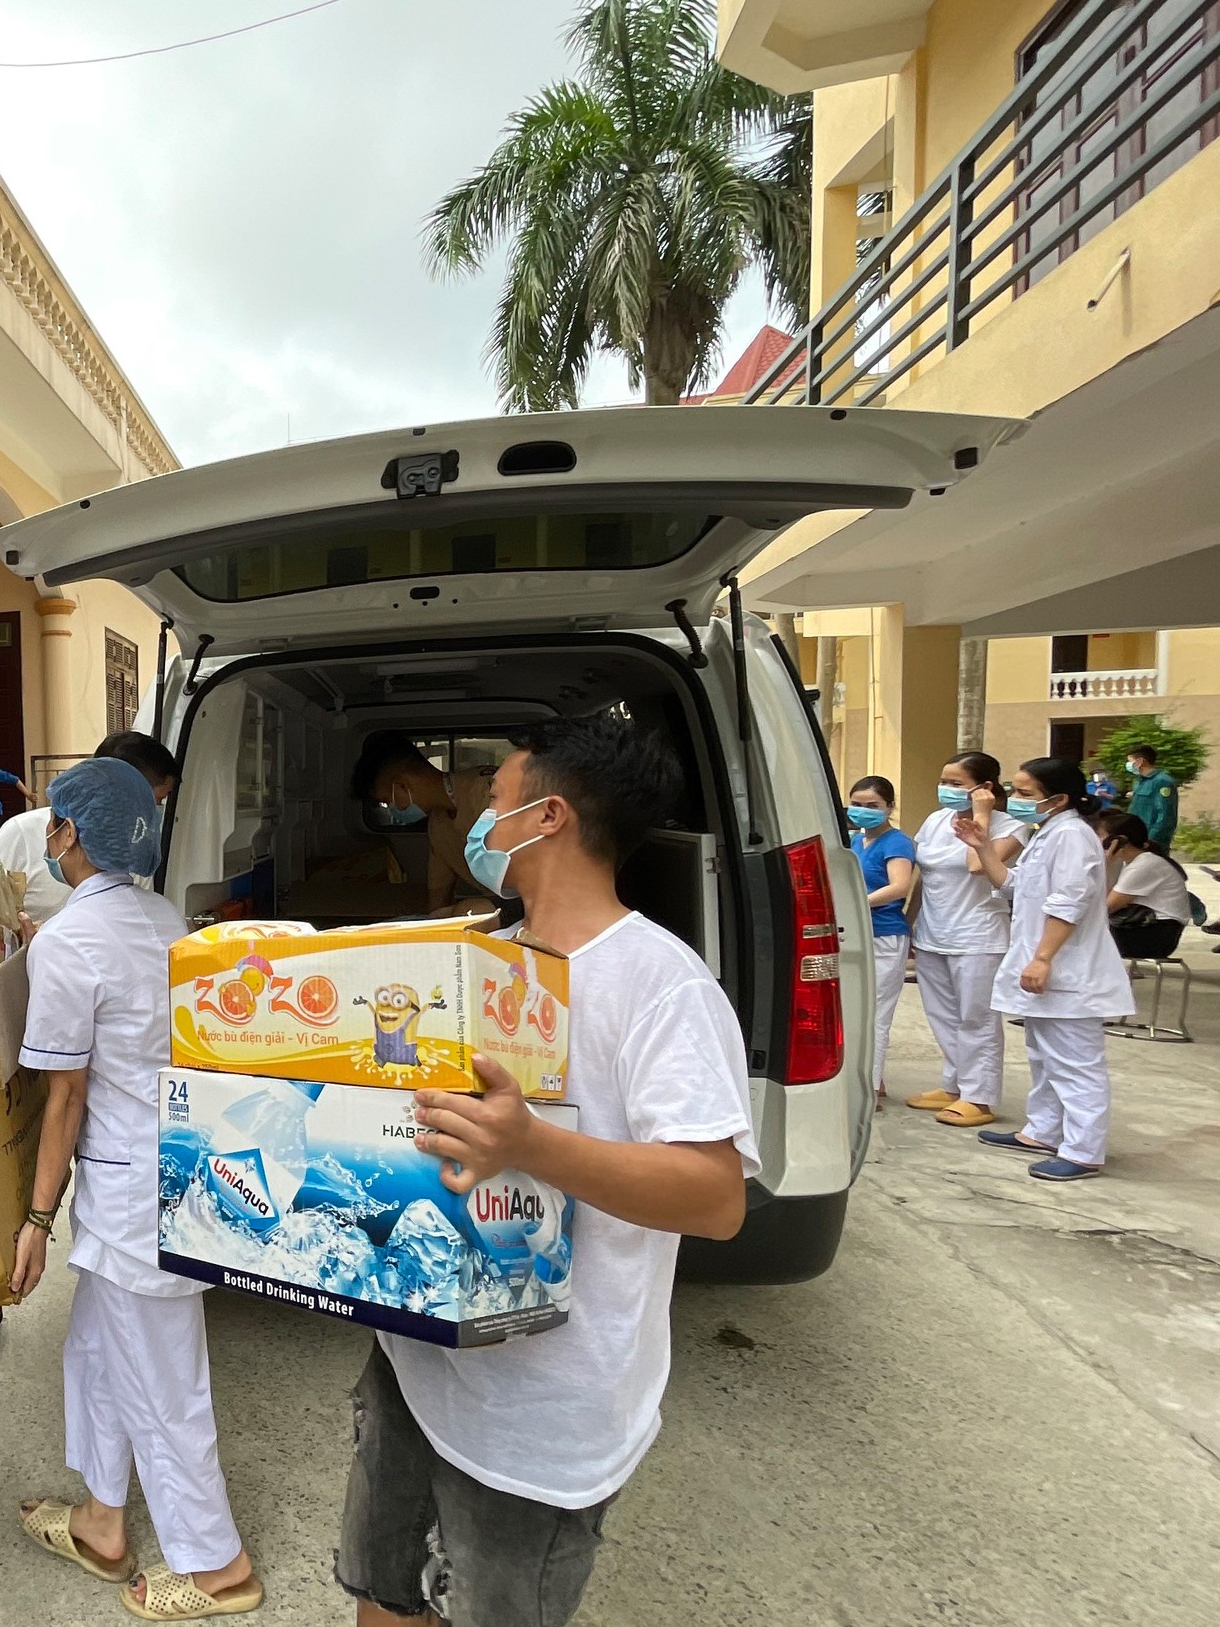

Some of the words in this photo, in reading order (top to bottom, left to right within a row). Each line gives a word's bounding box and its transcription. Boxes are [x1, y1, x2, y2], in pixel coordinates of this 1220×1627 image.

[224, 1031, 237, 1042] bù
[240, 1031, 262, 1045] điện
[265, 1031, 285, 1047] giải
[296, 1033, 308, 1047] Vị
[311, 1033, 339, 1045] Cam
[168, 1080, 189, 1102] 24
[168, 1112, 189, 1123] 500ml
[382, 1124, 445, 1139] HAB
[213, 1158, 269, 1216] UniAqua
[475, 1185, 545, 1222] UniAqu
[223, 1271, 263, 1293] Bottled
[266, 1282, 315, 1309] Drinking
[317, 1295, 354, 1316] Water
